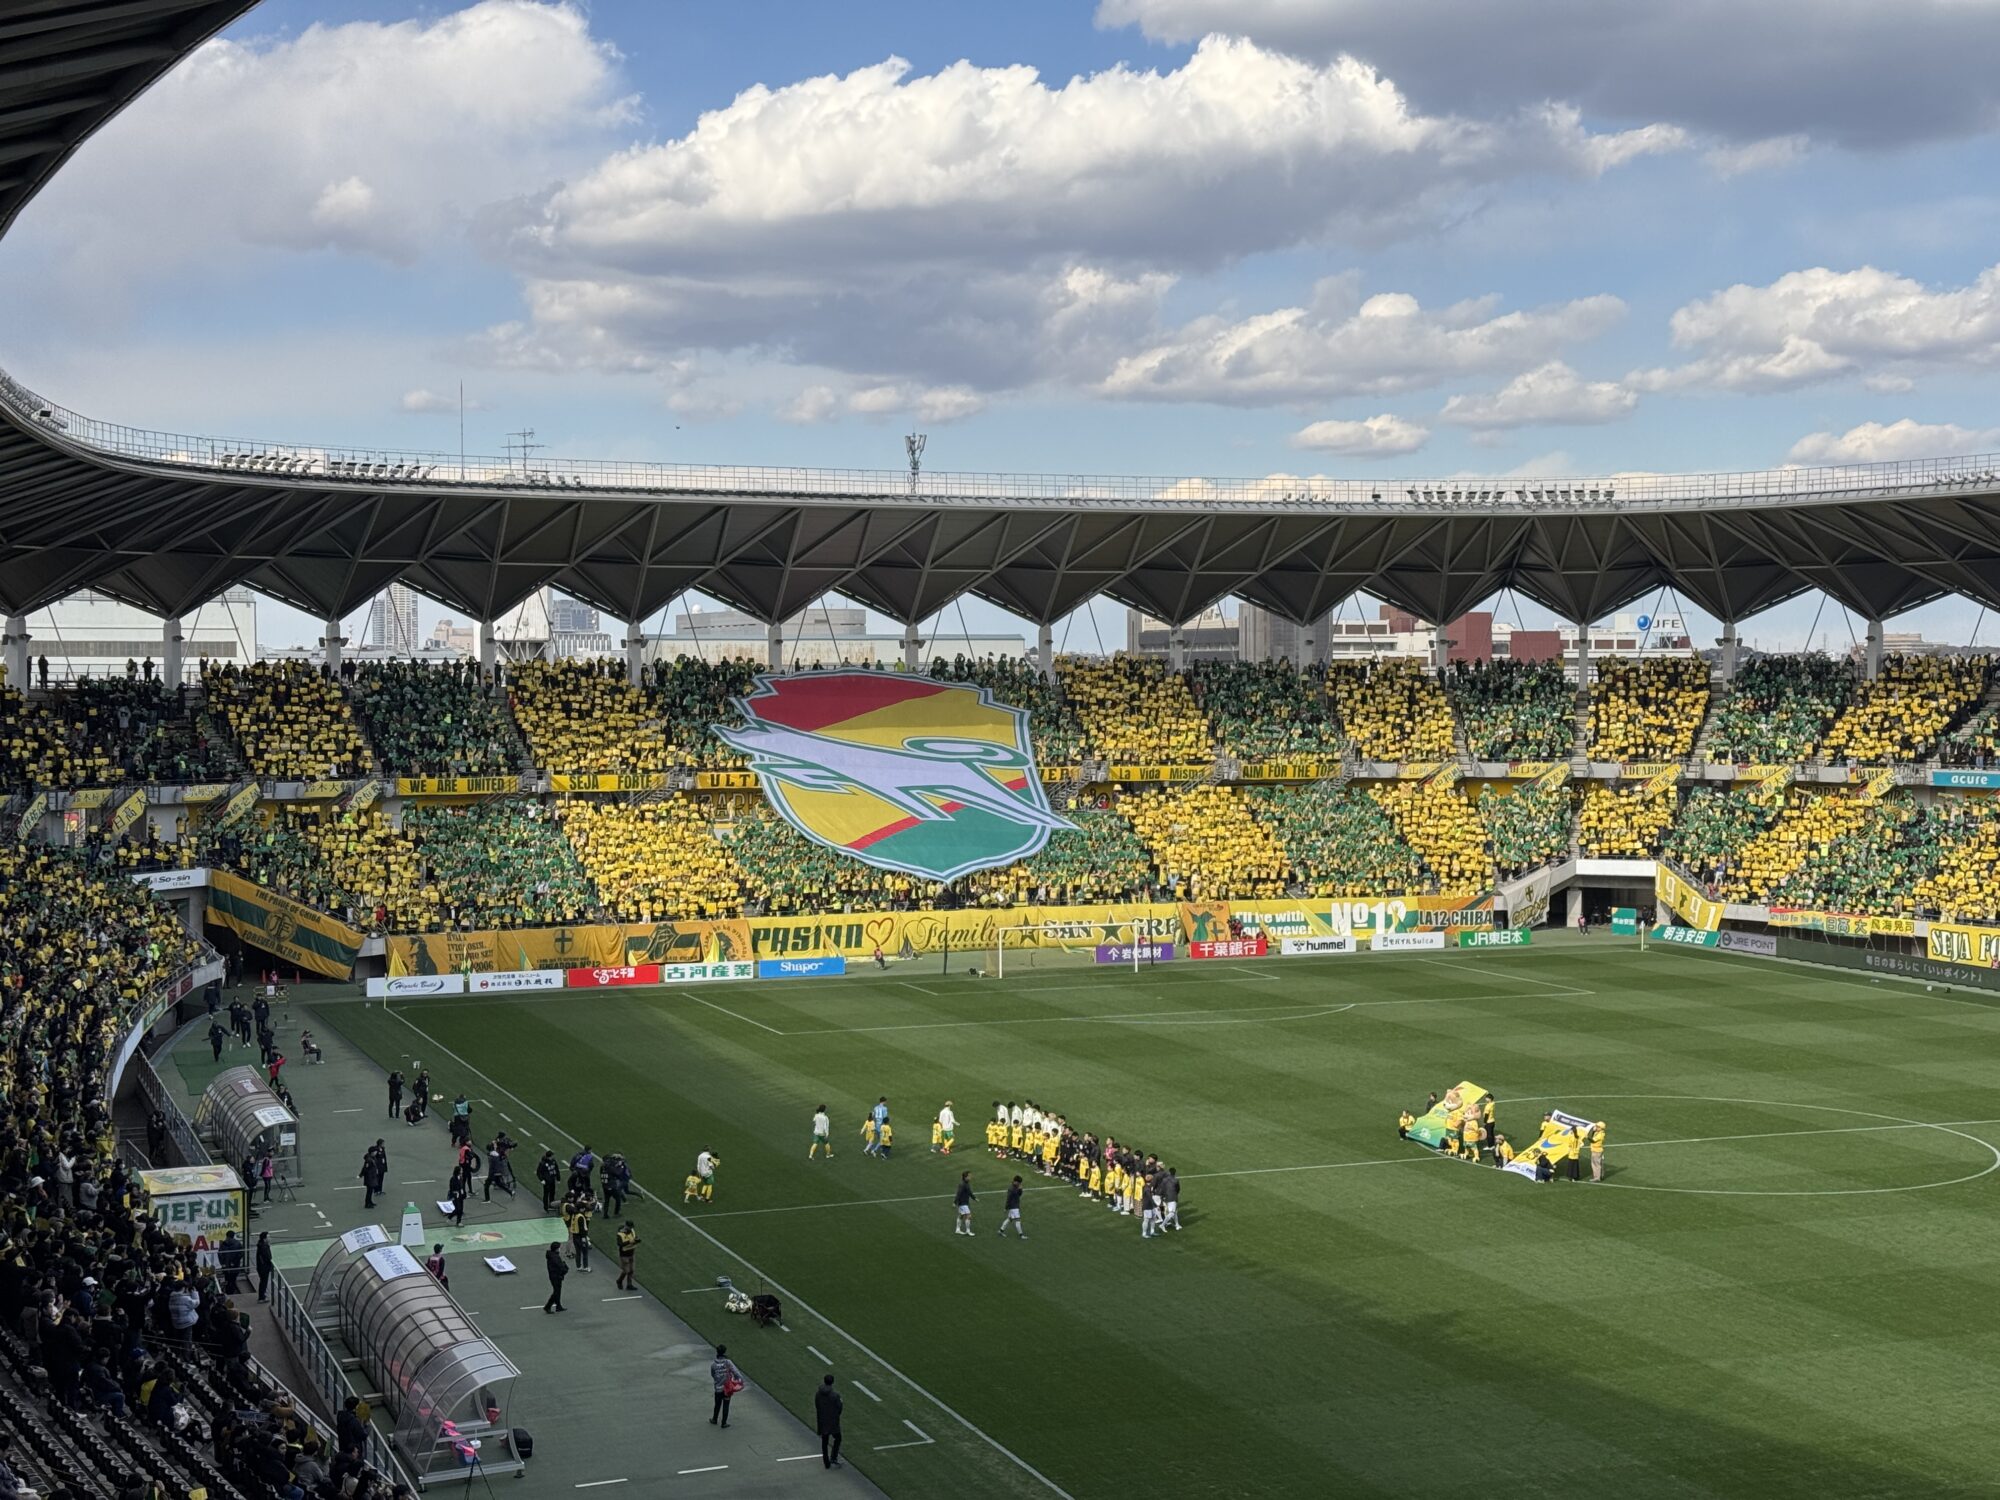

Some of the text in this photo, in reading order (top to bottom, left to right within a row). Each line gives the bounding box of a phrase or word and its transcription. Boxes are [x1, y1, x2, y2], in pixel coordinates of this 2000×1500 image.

[1653, 619, 1681, 629] JFE
[1119, 767, 1204, 780] La Vida Misma
[1242, 763, 1335, 779] AIM FOR THE TOP
[409, 779, 506, 793] WE ARE UNITED
[569, 774, 653, 790] SEJA FORTE
[1951, 775, 1988, 785] acure
[1274, 910, 1305, 923] with
[1419, 909, 1448, 926] LA12
[1450, 909, 1494, 926] CHIBA
[903, 915, 1011, 952] Familia
[1043, 919, 1095, 939] SAN
[1663, 926, 1708, 944] 明治安田
[1306, 939, 1346, 951] hummel
[1467, 930, 1525, 946] JR東日本
[1733, 937, 1775, 951] JRE POINT
[1931, 928, 1972, 962] SEJA
[1199, 941, 1258, 957] 千葉銀行
[667, 964, 753, 980] 古河産業
[780, 961, 824, 974] Shapo
[197, 1221, 240, 1232] ICHIHARA
